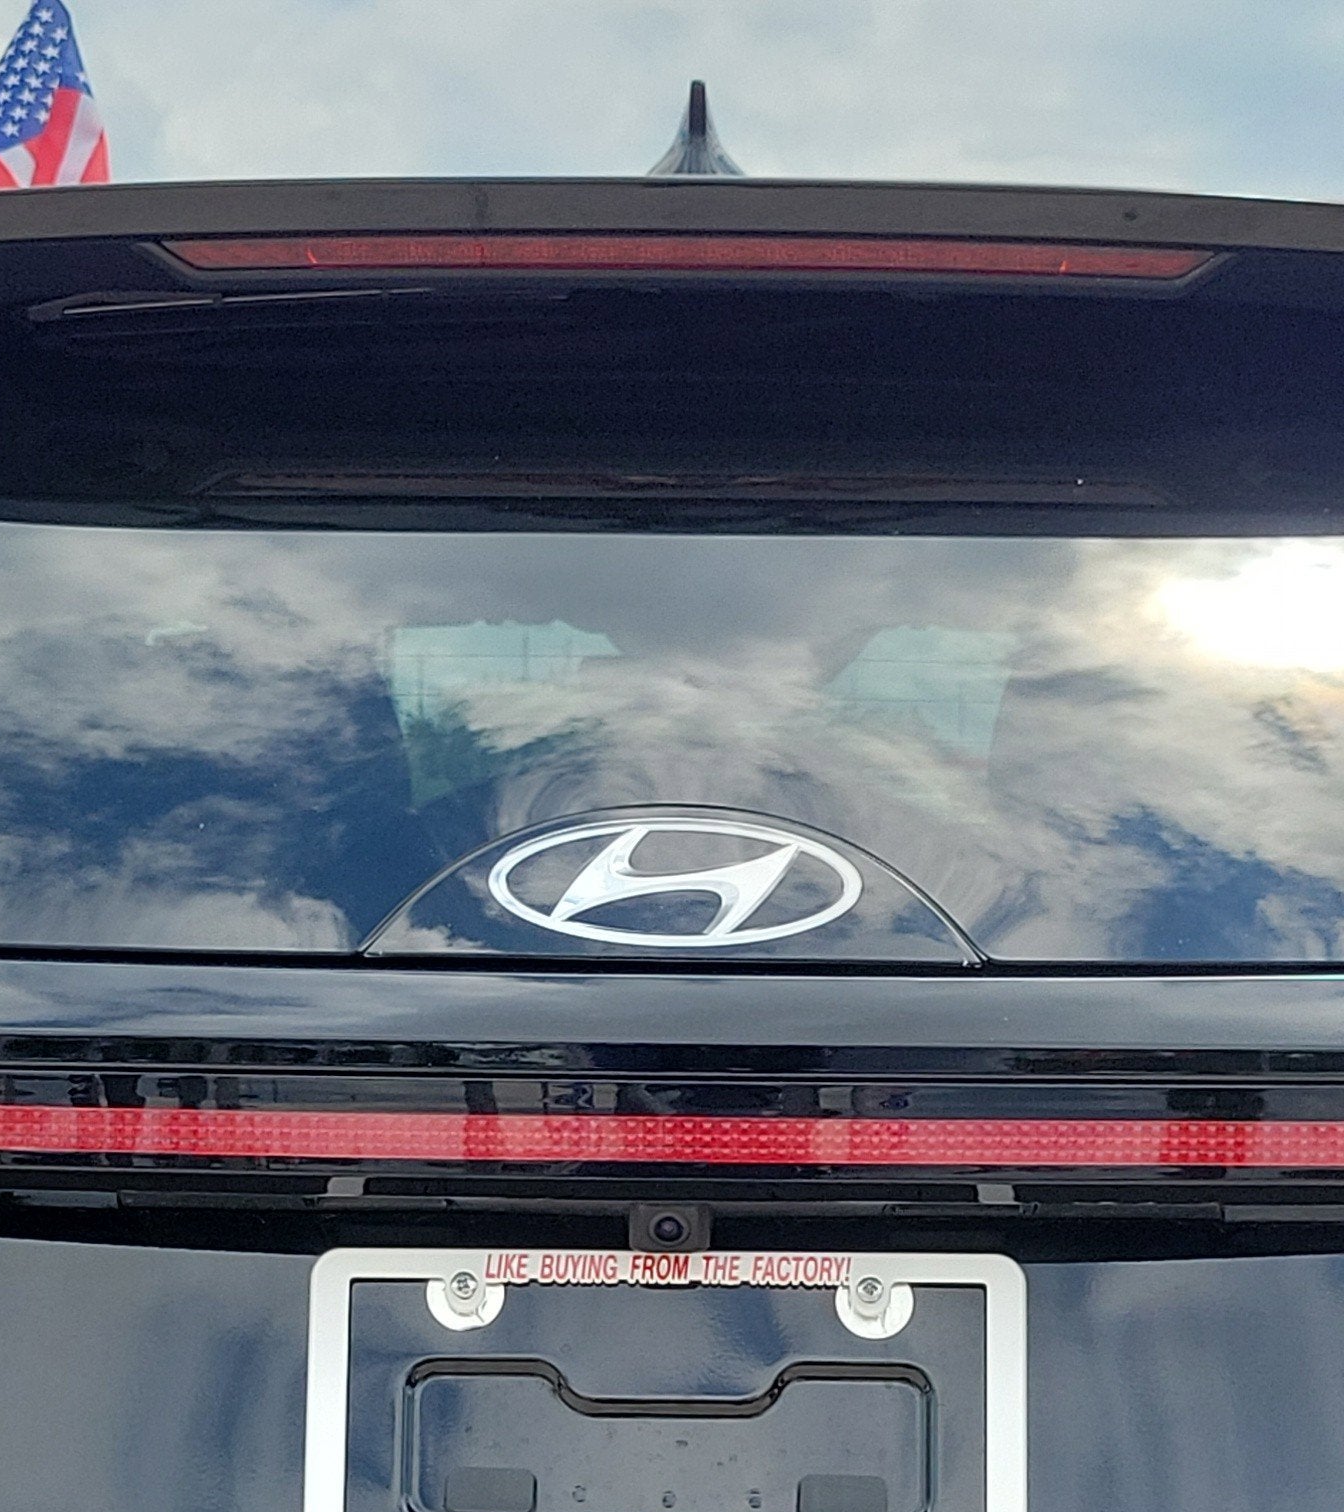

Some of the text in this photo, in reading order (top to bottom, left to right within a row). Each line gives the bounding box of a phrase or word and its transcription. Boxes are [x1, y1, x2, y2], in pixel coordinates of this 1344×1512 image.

[485, 1253, 852, 1283] LIKE BUYING FROM THE FACTORY!
